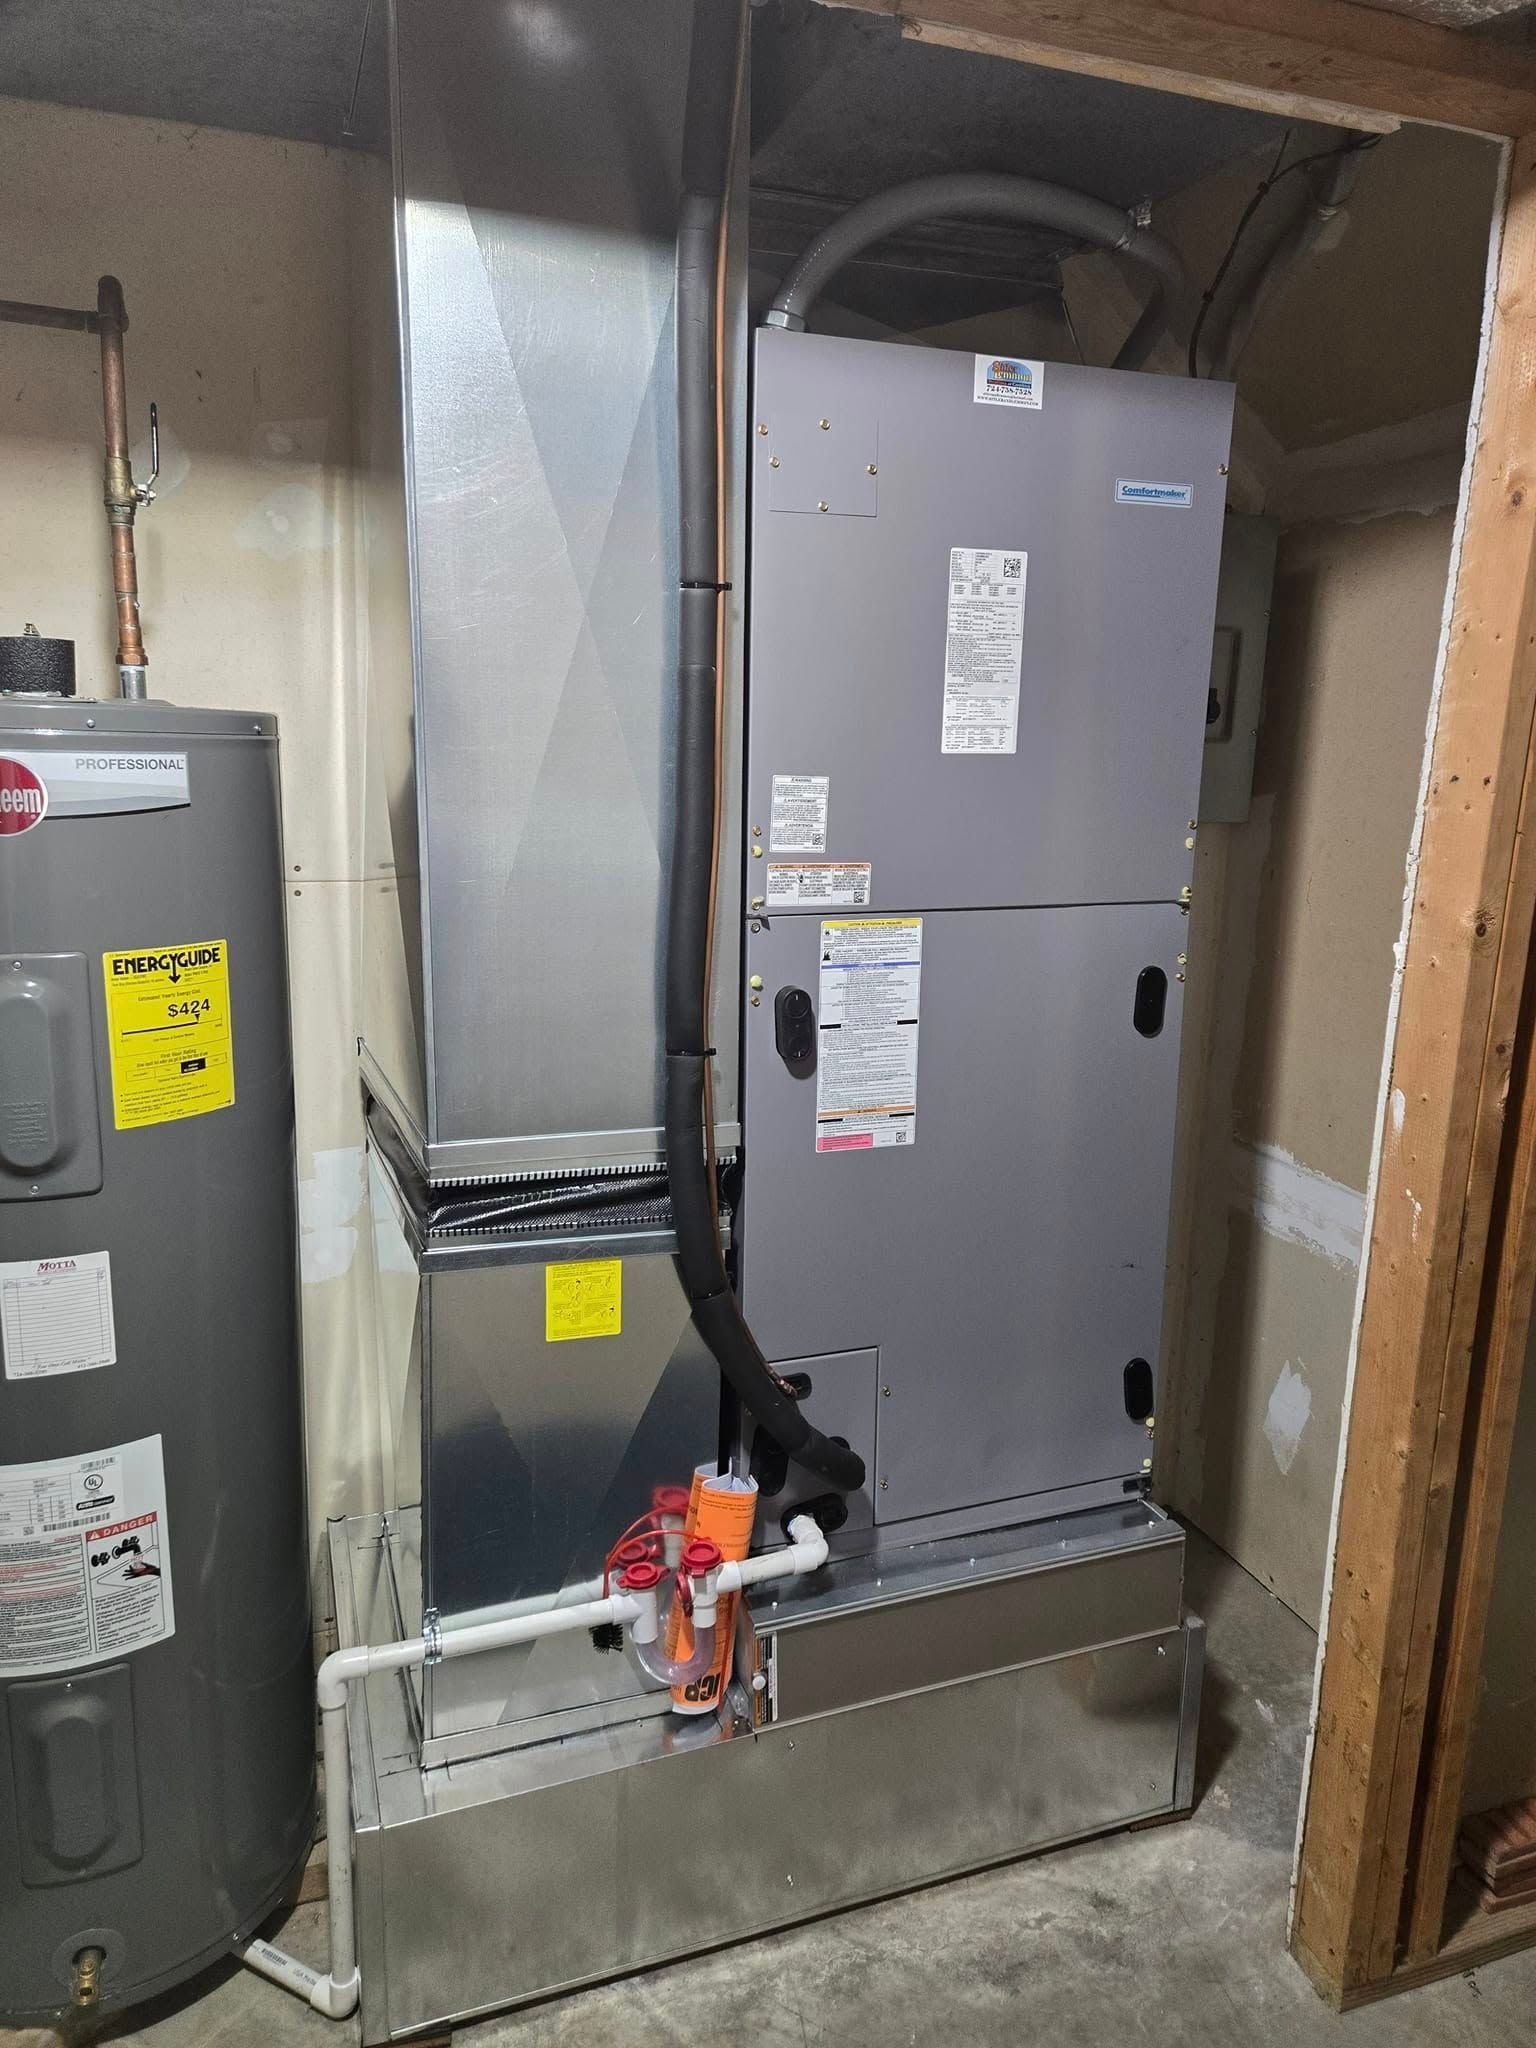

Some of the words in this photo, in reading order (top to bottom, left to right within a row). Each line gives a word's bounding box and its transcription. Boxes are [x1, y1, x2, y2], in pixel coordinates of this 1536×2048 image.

[1122, 485, 1186, 498] Comfortmaker
[75, 758, 183, 770] PROFESSIONAL
[0, 787, 42, 813] eem
[112, 947, 221, 977] ENERGYGUIDE
[167, 998, 211, 1018] $424
[37, 1260, 77, 1272] MOTTA
[103, 1514, 153, 1537] DANGER
